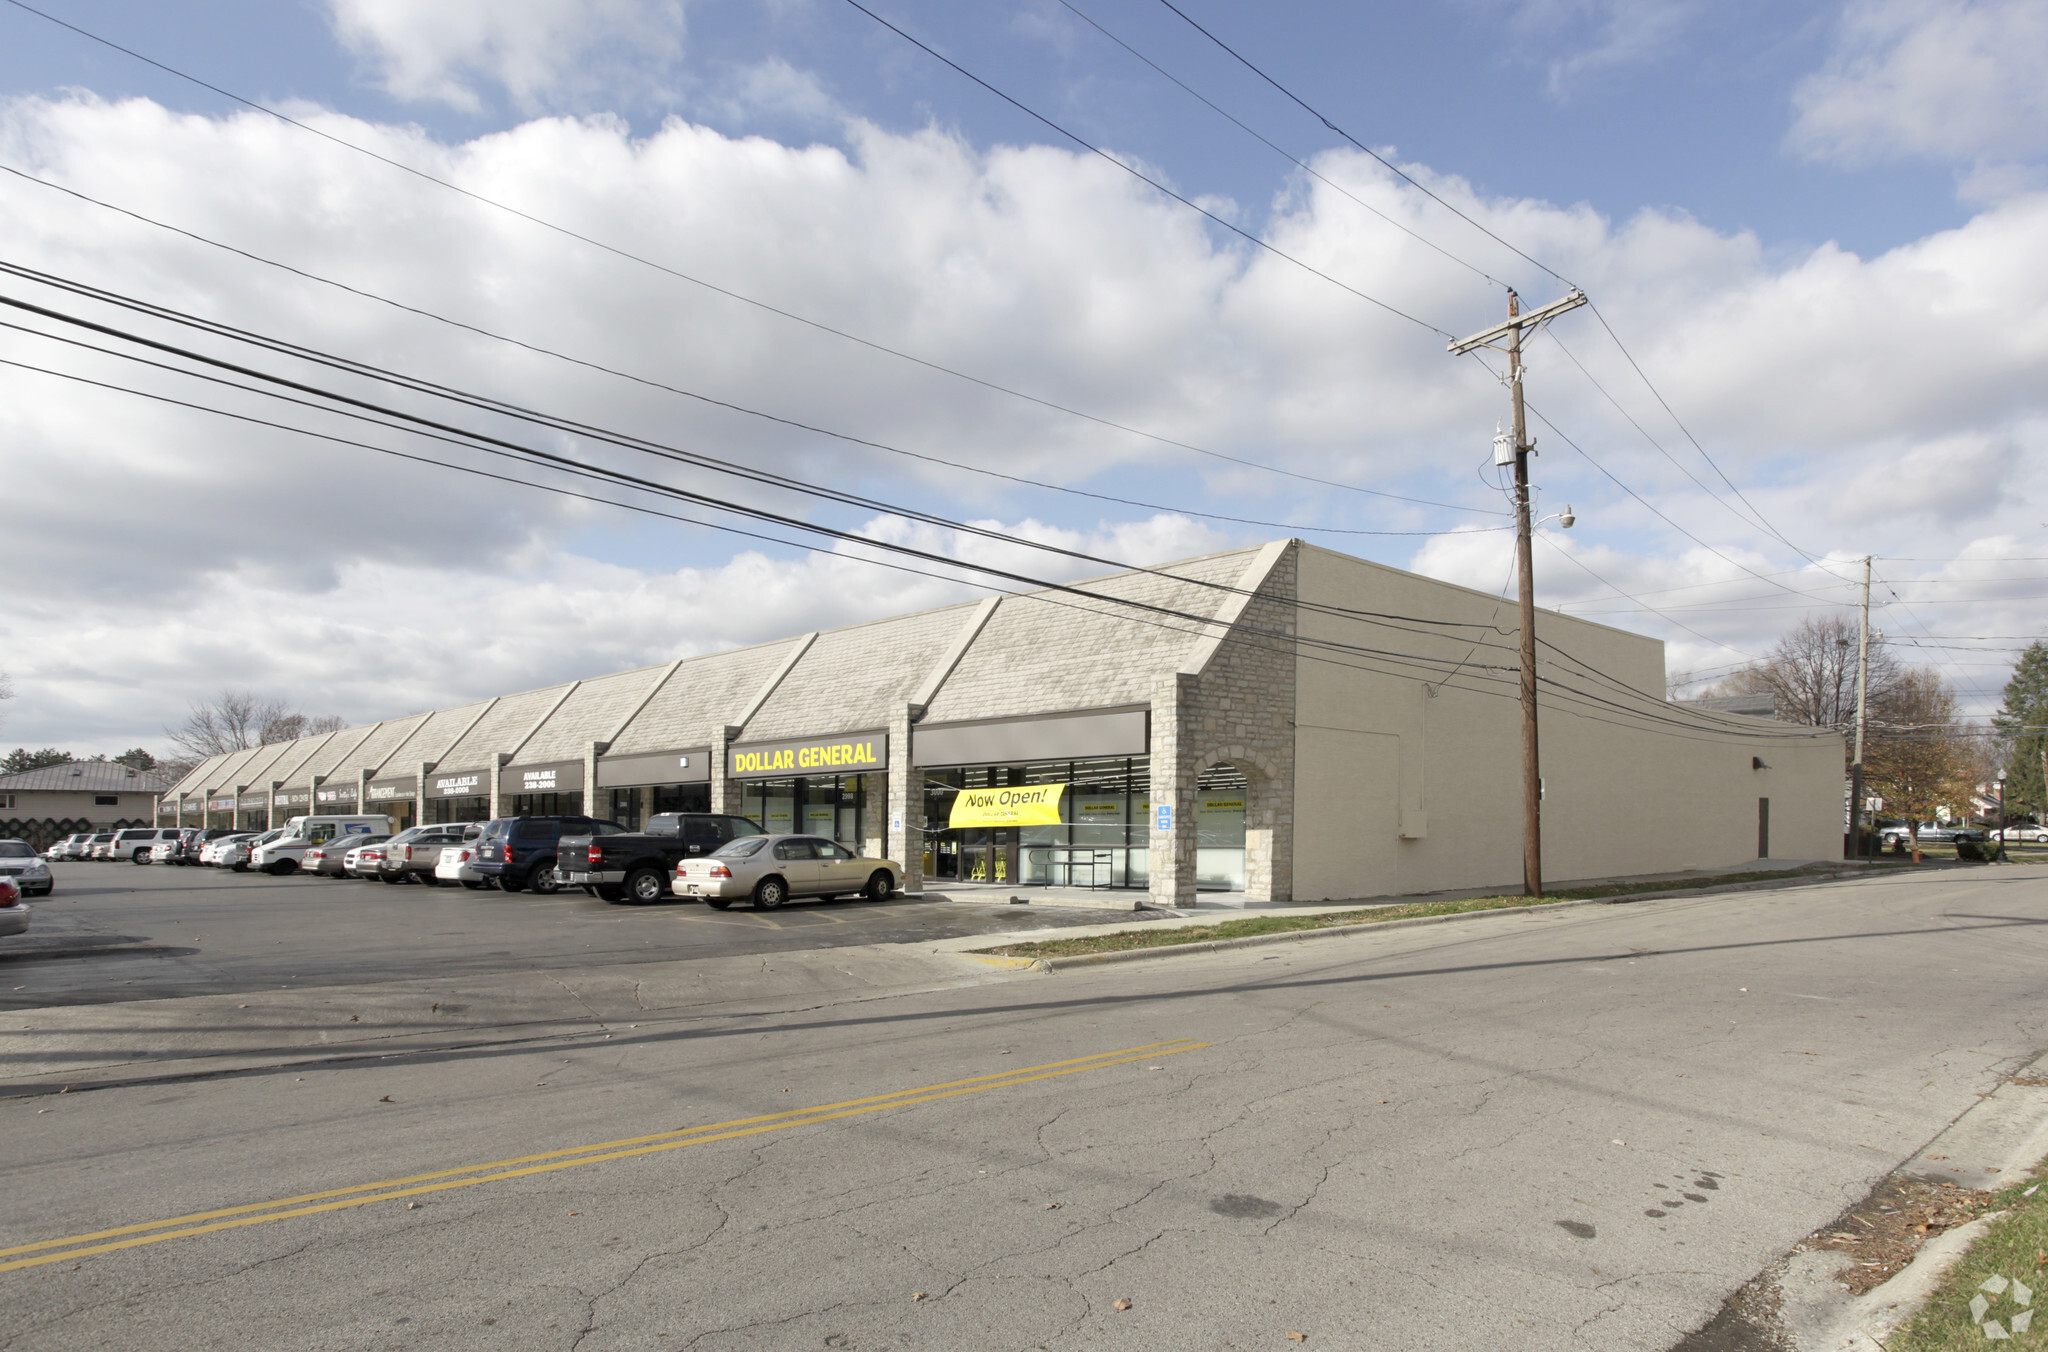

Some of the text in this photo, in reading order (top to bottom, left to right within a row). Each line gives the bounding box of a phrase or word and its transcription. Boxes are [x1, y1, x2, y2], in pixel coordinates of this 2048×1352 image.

[735, 743, 876, 772] DOLLAR GENERAL
[523, 770, 557, 780] AVAILABLE
[436, 776, 478, 789] AVAILABLE
[524, 780, 556, 789] 238-2006
[443, 786, 470, 795] 238-2006
[965, 789, 1048, 808] Now Open!
